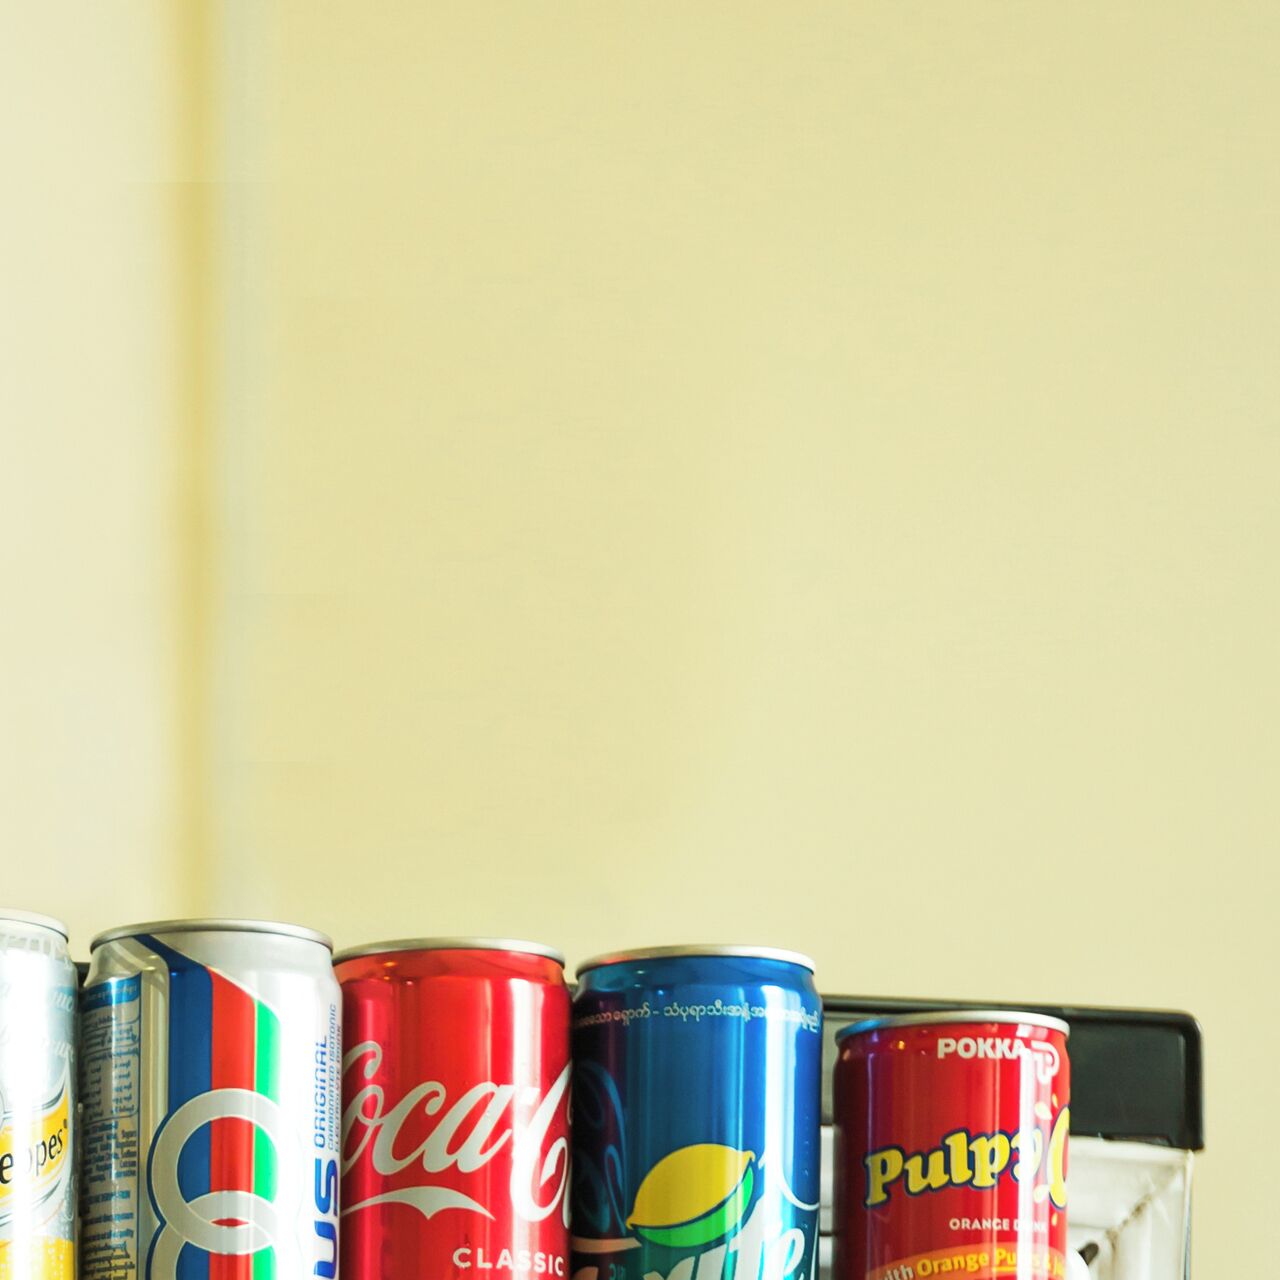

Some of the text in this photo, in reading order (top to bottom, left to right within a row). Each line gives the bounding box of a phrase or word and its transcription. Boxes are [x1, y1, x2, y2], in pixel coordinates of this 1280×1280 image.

[937, 1037, 1028, 1060] POKKA
[313, 1035, 327, 1149] ORIGINAL
[863, 1127, 1043, 1209] Pulpy
[949, 1217, 1009, 1232] ORANGE
[453, 1247, 565, 1277] CLASSIC
[916, 1250, 989, 1277] Orange
